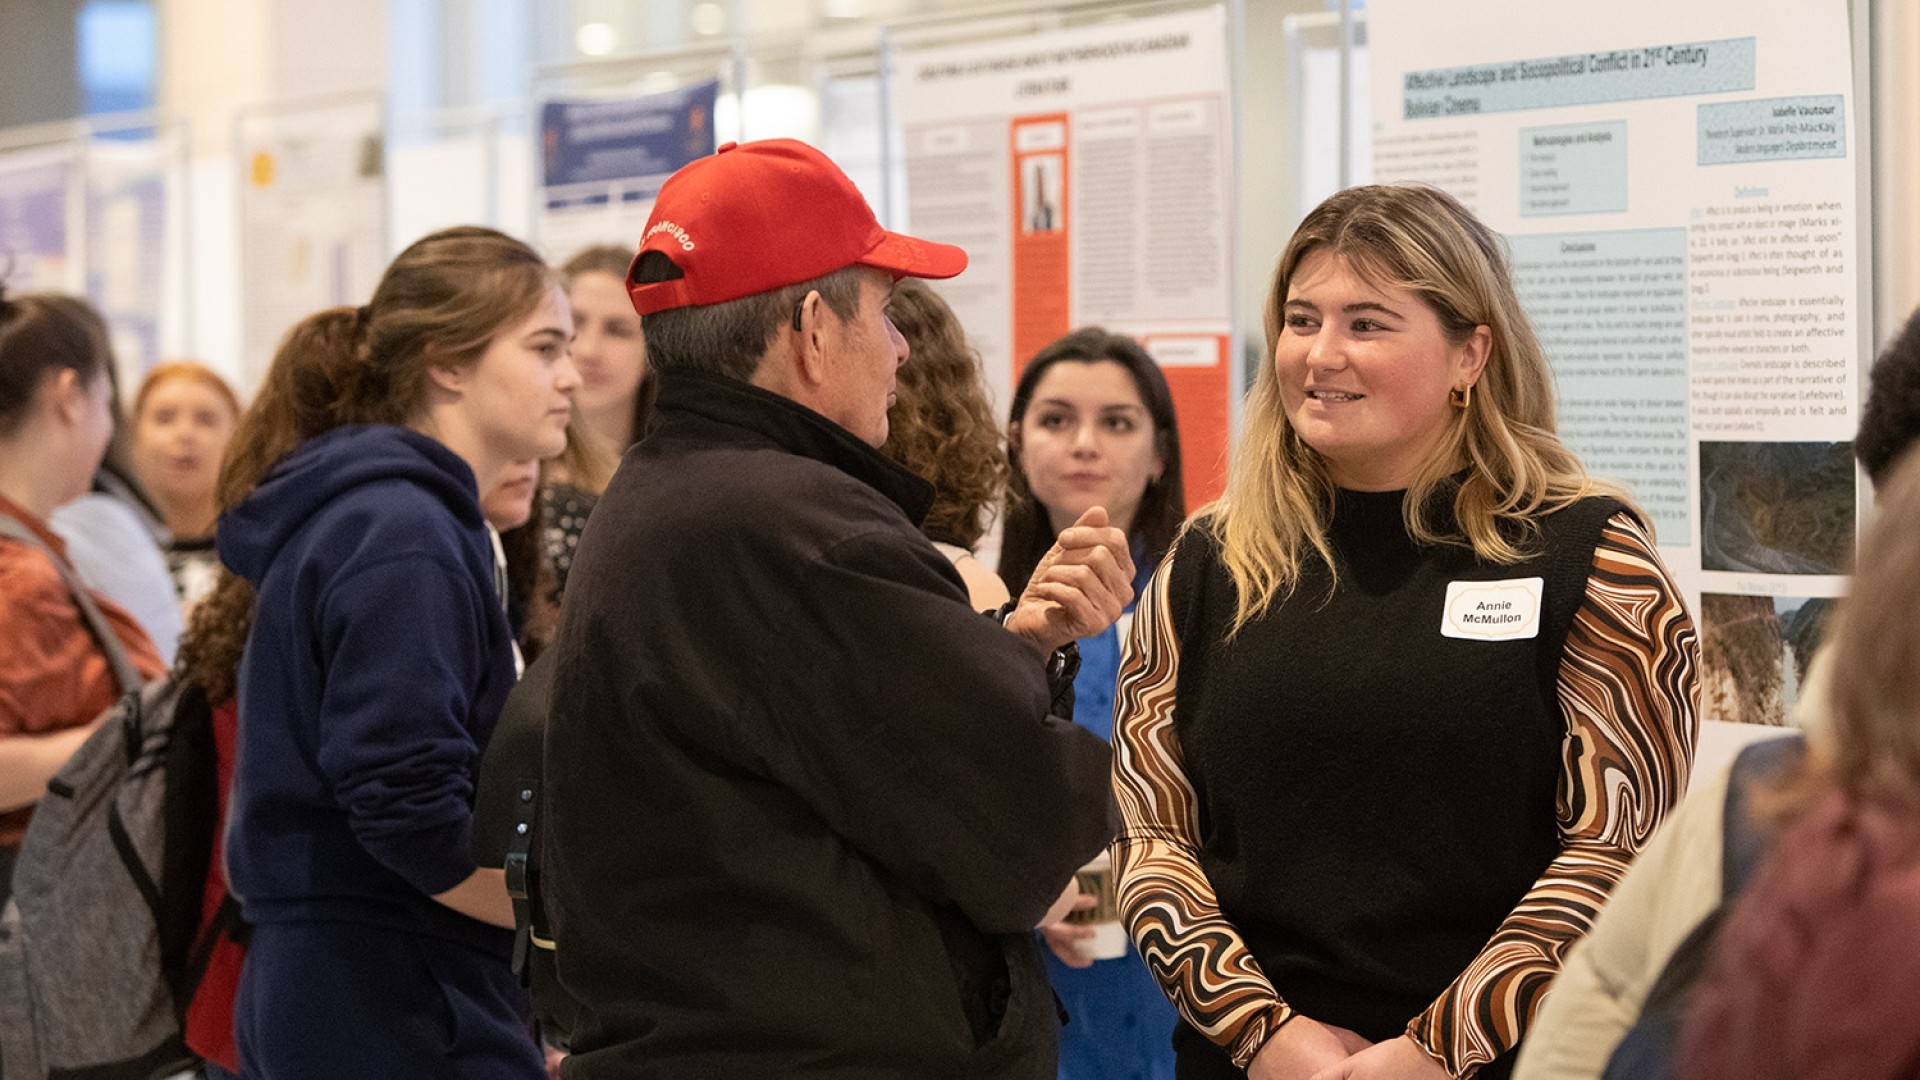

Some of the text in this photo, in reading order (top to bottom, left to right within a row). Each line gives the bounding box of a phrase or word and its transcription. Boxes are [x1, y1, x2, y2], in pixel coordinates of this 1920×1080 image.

[1590, 52, 1629, 73] Conflict
[1631, 51, 1641, 69] in
[1664, 45, 1709, 68] Century
[1798, 105, 1836, 116] Vautour
[1816, 201, 1842, 210] when
[1786, 248, 1816, 260] thought
[1819, 248, 1829, 258] of
[1832, 250, 1844, 258] as
[1825, 264, 1844, 273] and
[1799, 295, 1845, 306] essentially
[1826, 312, 1845, 321] and
[1806, 328, 1846, 337] affective
[1802, 359, 1846, 368] described
[1795, 375, 1834, 384] narrative
[1836, 374, 1847, 383] of
[1809, 405, 1824, 415] felt
[1828, 405, 1848, 415] and
[1476, 601, 1513, 611] Annie
